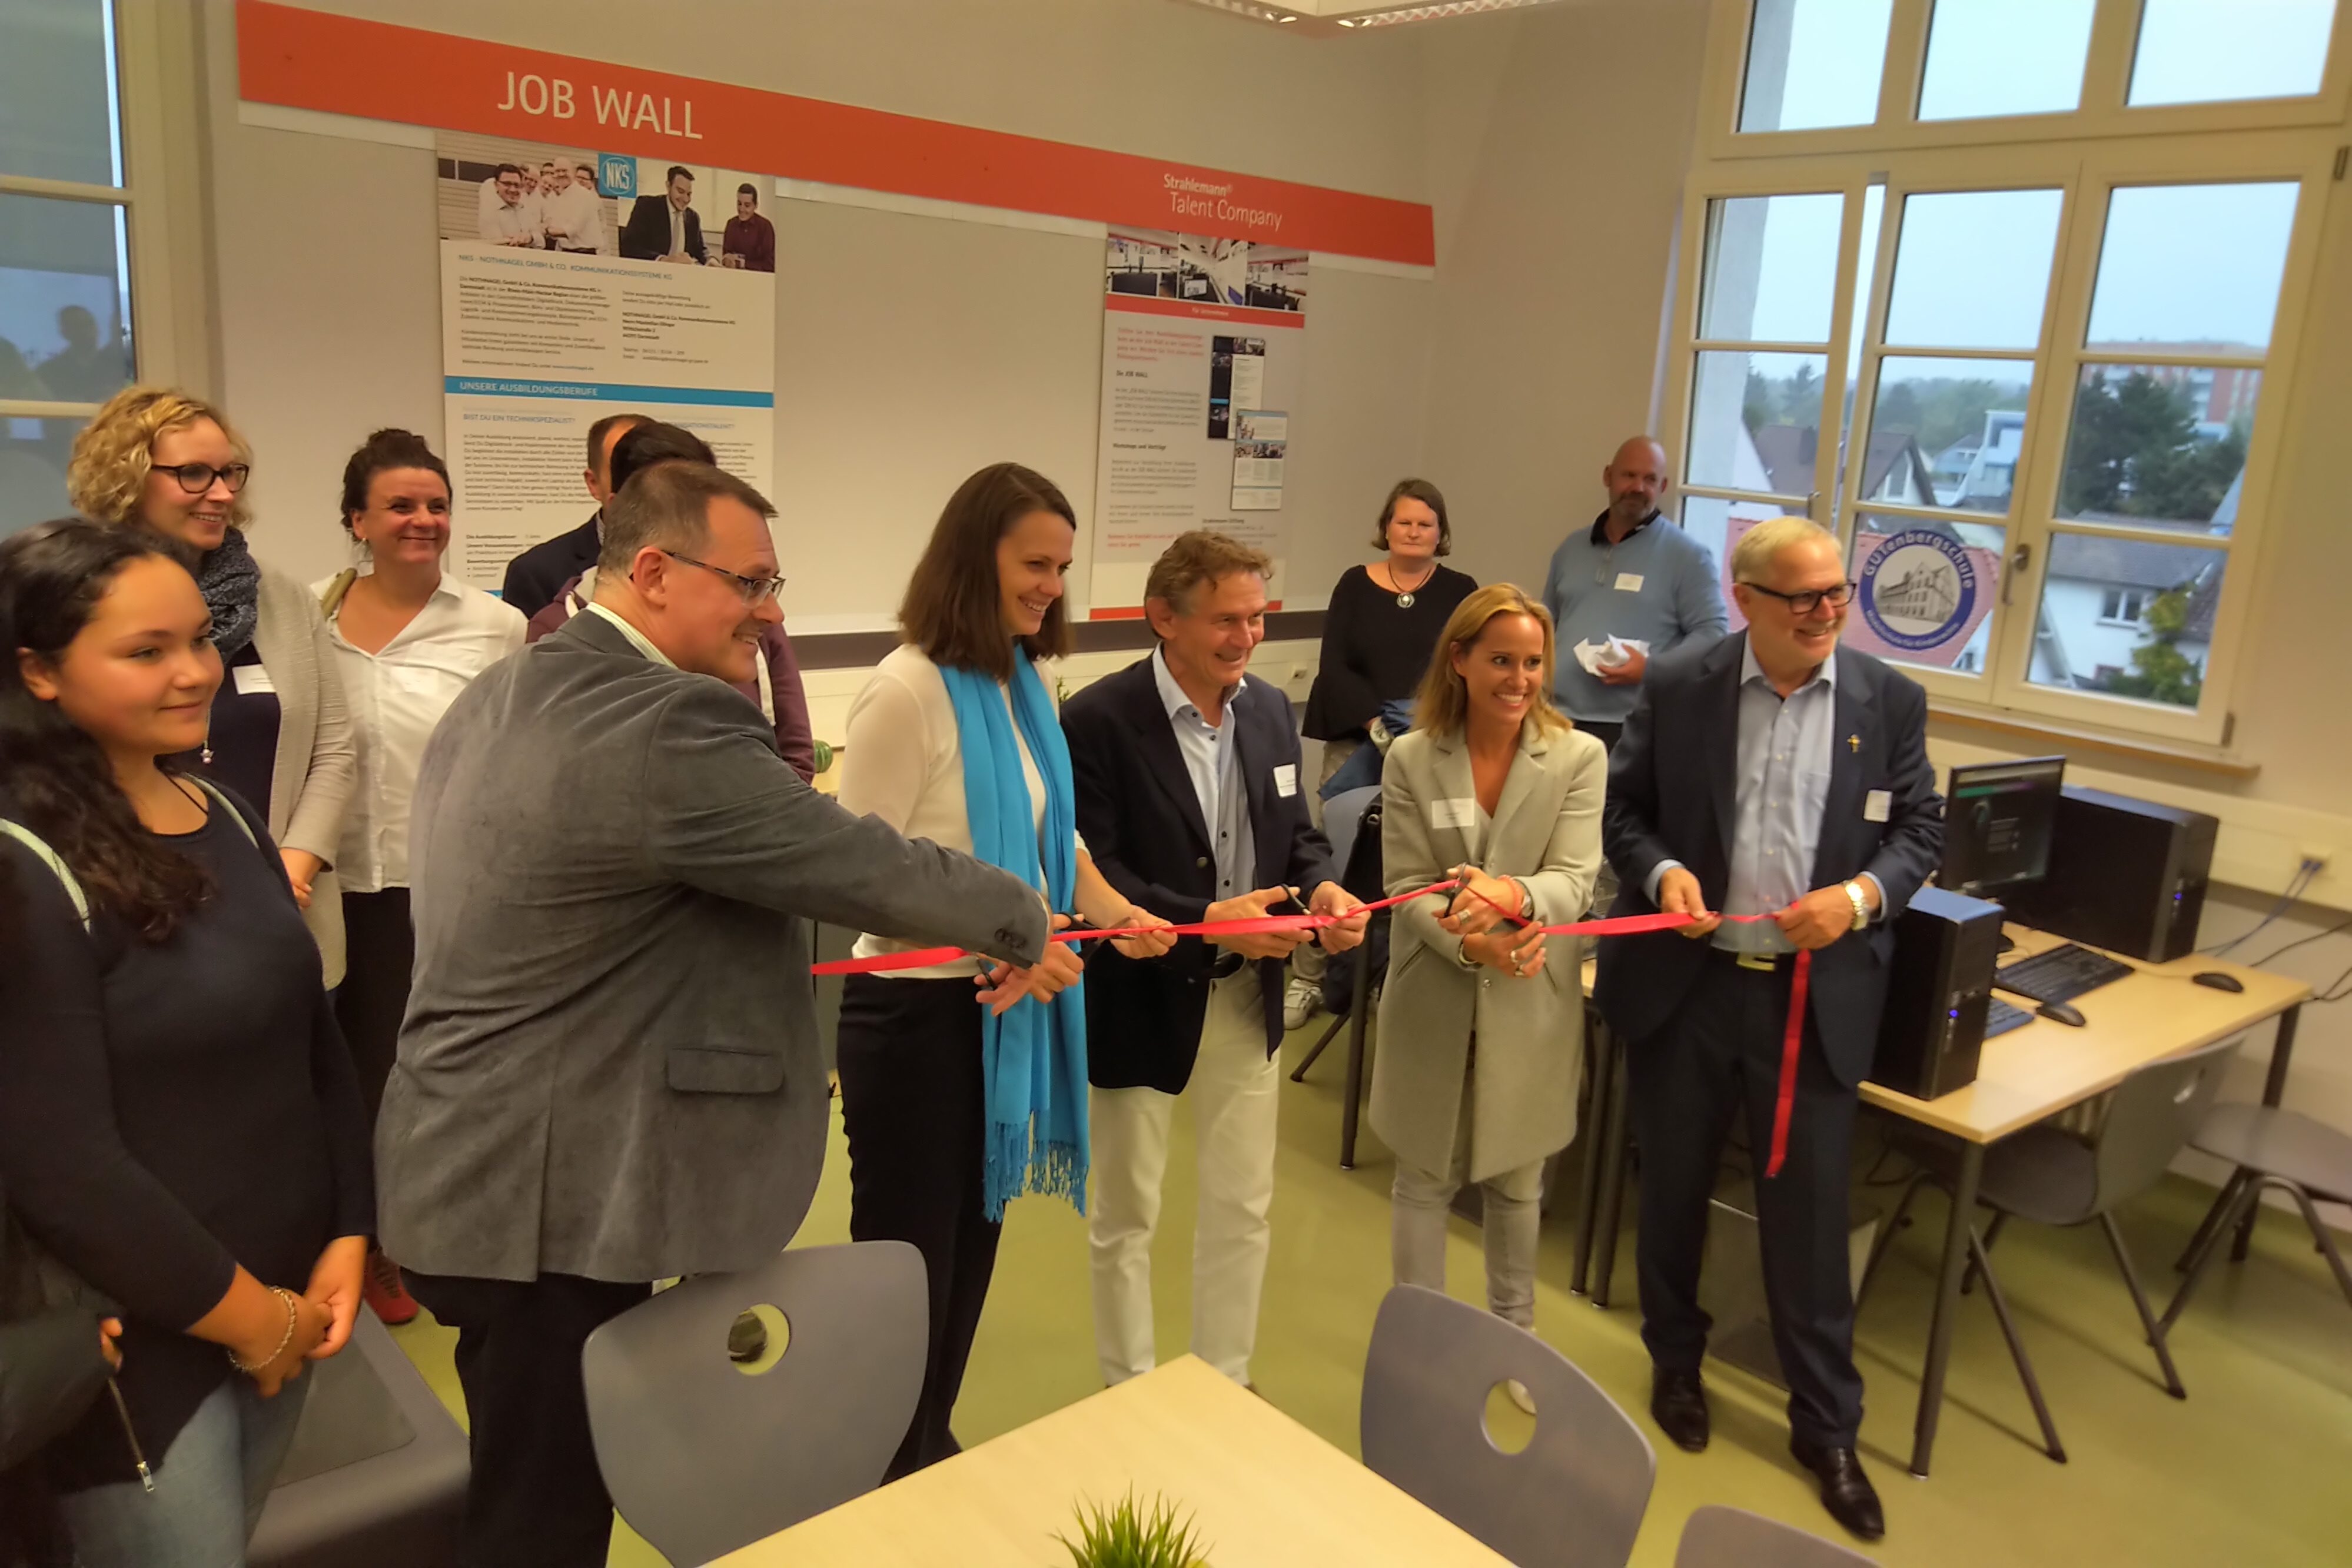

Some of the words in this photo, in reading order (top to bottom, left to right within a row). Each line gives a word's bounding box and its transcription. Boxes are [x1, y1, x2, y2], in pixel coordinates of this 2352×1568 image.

[497, 71, 576, 119] JOB
[592, 85, 703, 139] WALL
[606, 162, 630, 189] NKS
[1170, 191, 1213, 218] Talent
[1217, 199, 1283, 232] Company
[460, 381, 497, 391] UNSERE
[499, 384, 598, 396] AUSBILDUNGSBERUFE
